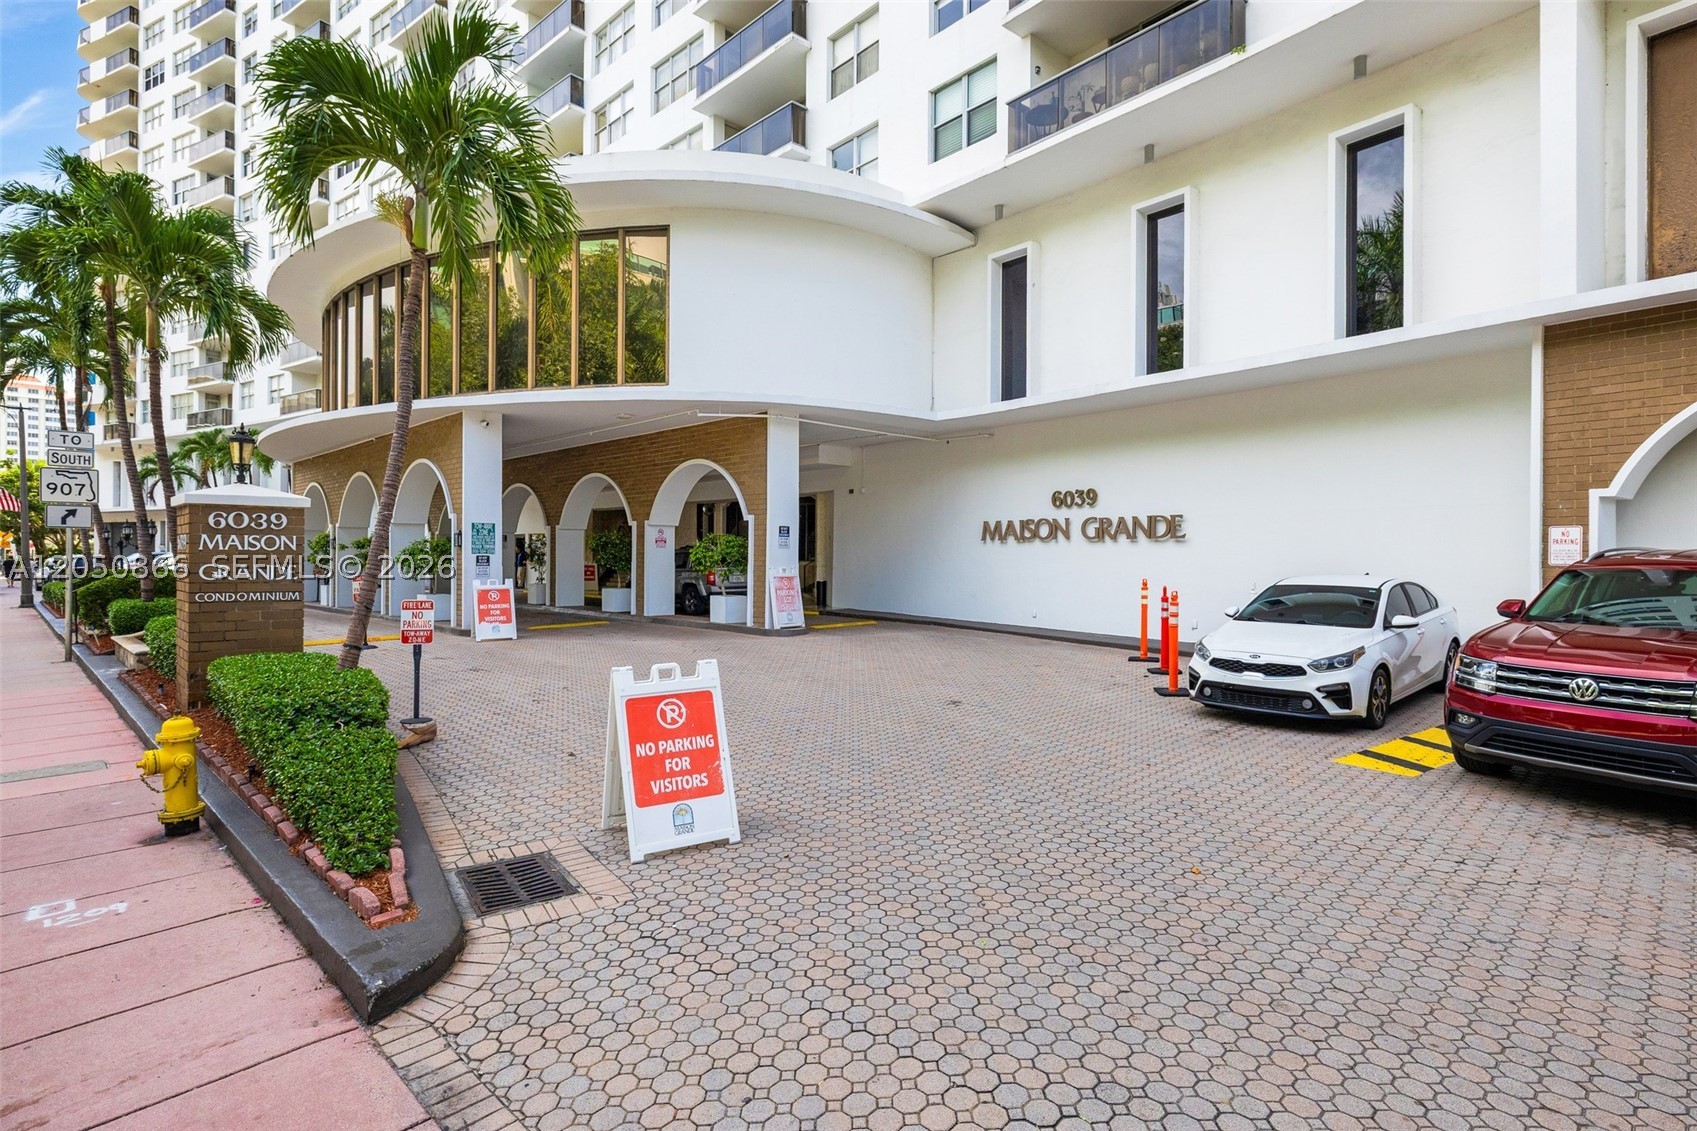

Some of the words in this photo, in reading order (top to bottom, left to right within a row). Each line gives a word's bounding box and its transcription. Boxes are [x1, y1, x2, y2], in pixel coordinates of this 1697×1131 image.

[60, 434, 82, 446] TO
[51, 452, 91, 466] SOUTH
[46, 482, 86, 497] 907
[1051, 488, 1098, 509] 6039
[208, 511, 288, 530] 6039
[981, 517, 1071, 543] MAISON
[1081, 514, 1187, 543] GRANDE
[1561, 530, 1570, 538] NO
[198, 534, 297, 551] MAISON
[195, 592, 300, 603] CONDOMINIUM
[411, 611, 424, 620] NO
[402, 620, 432, 629] PARKING
[635, 742, 656, 758] NO
[659, 734, 715, 755] PARKING
[665, 756, 691, 773] FOR
[650, 772, 709, 795] VISITORS
